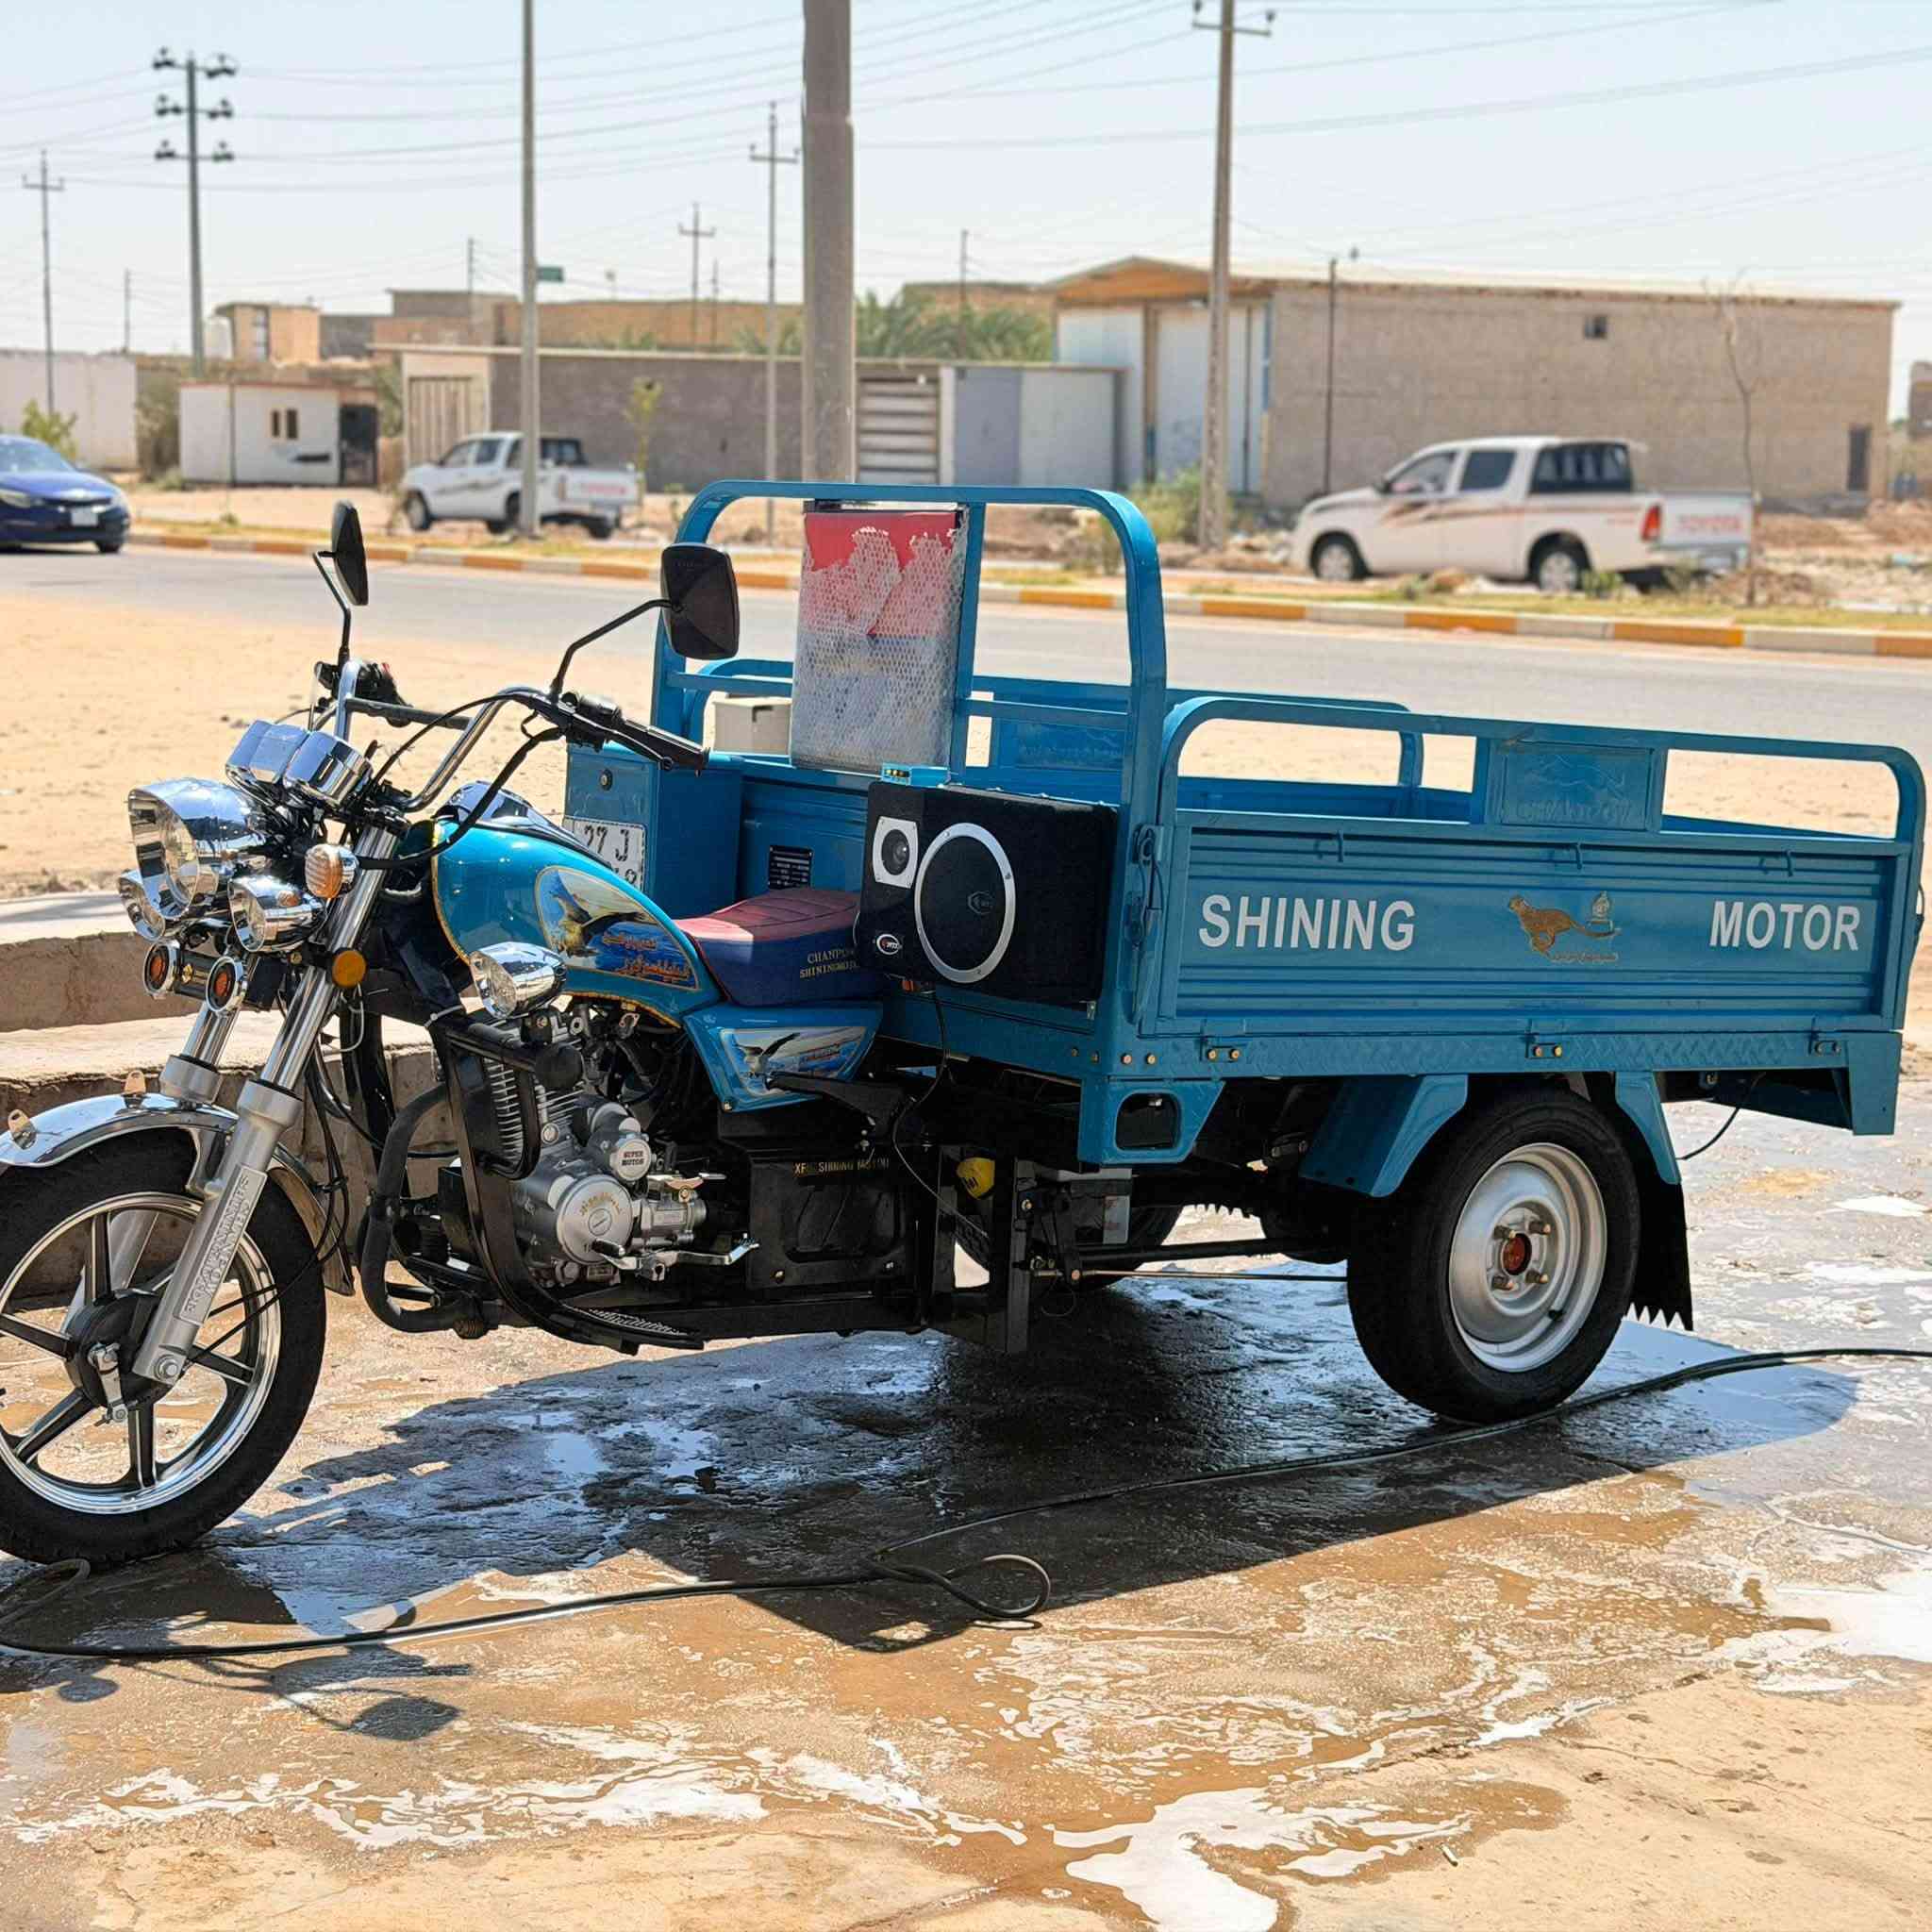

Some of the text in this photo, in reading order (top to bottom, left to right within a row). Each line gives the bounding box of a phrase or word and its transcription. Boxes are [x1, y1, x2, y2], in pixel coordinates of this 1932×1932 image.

[615, 829, 629, 861] J
[1199, 894, 1860, 951] SHINING MOTOR
